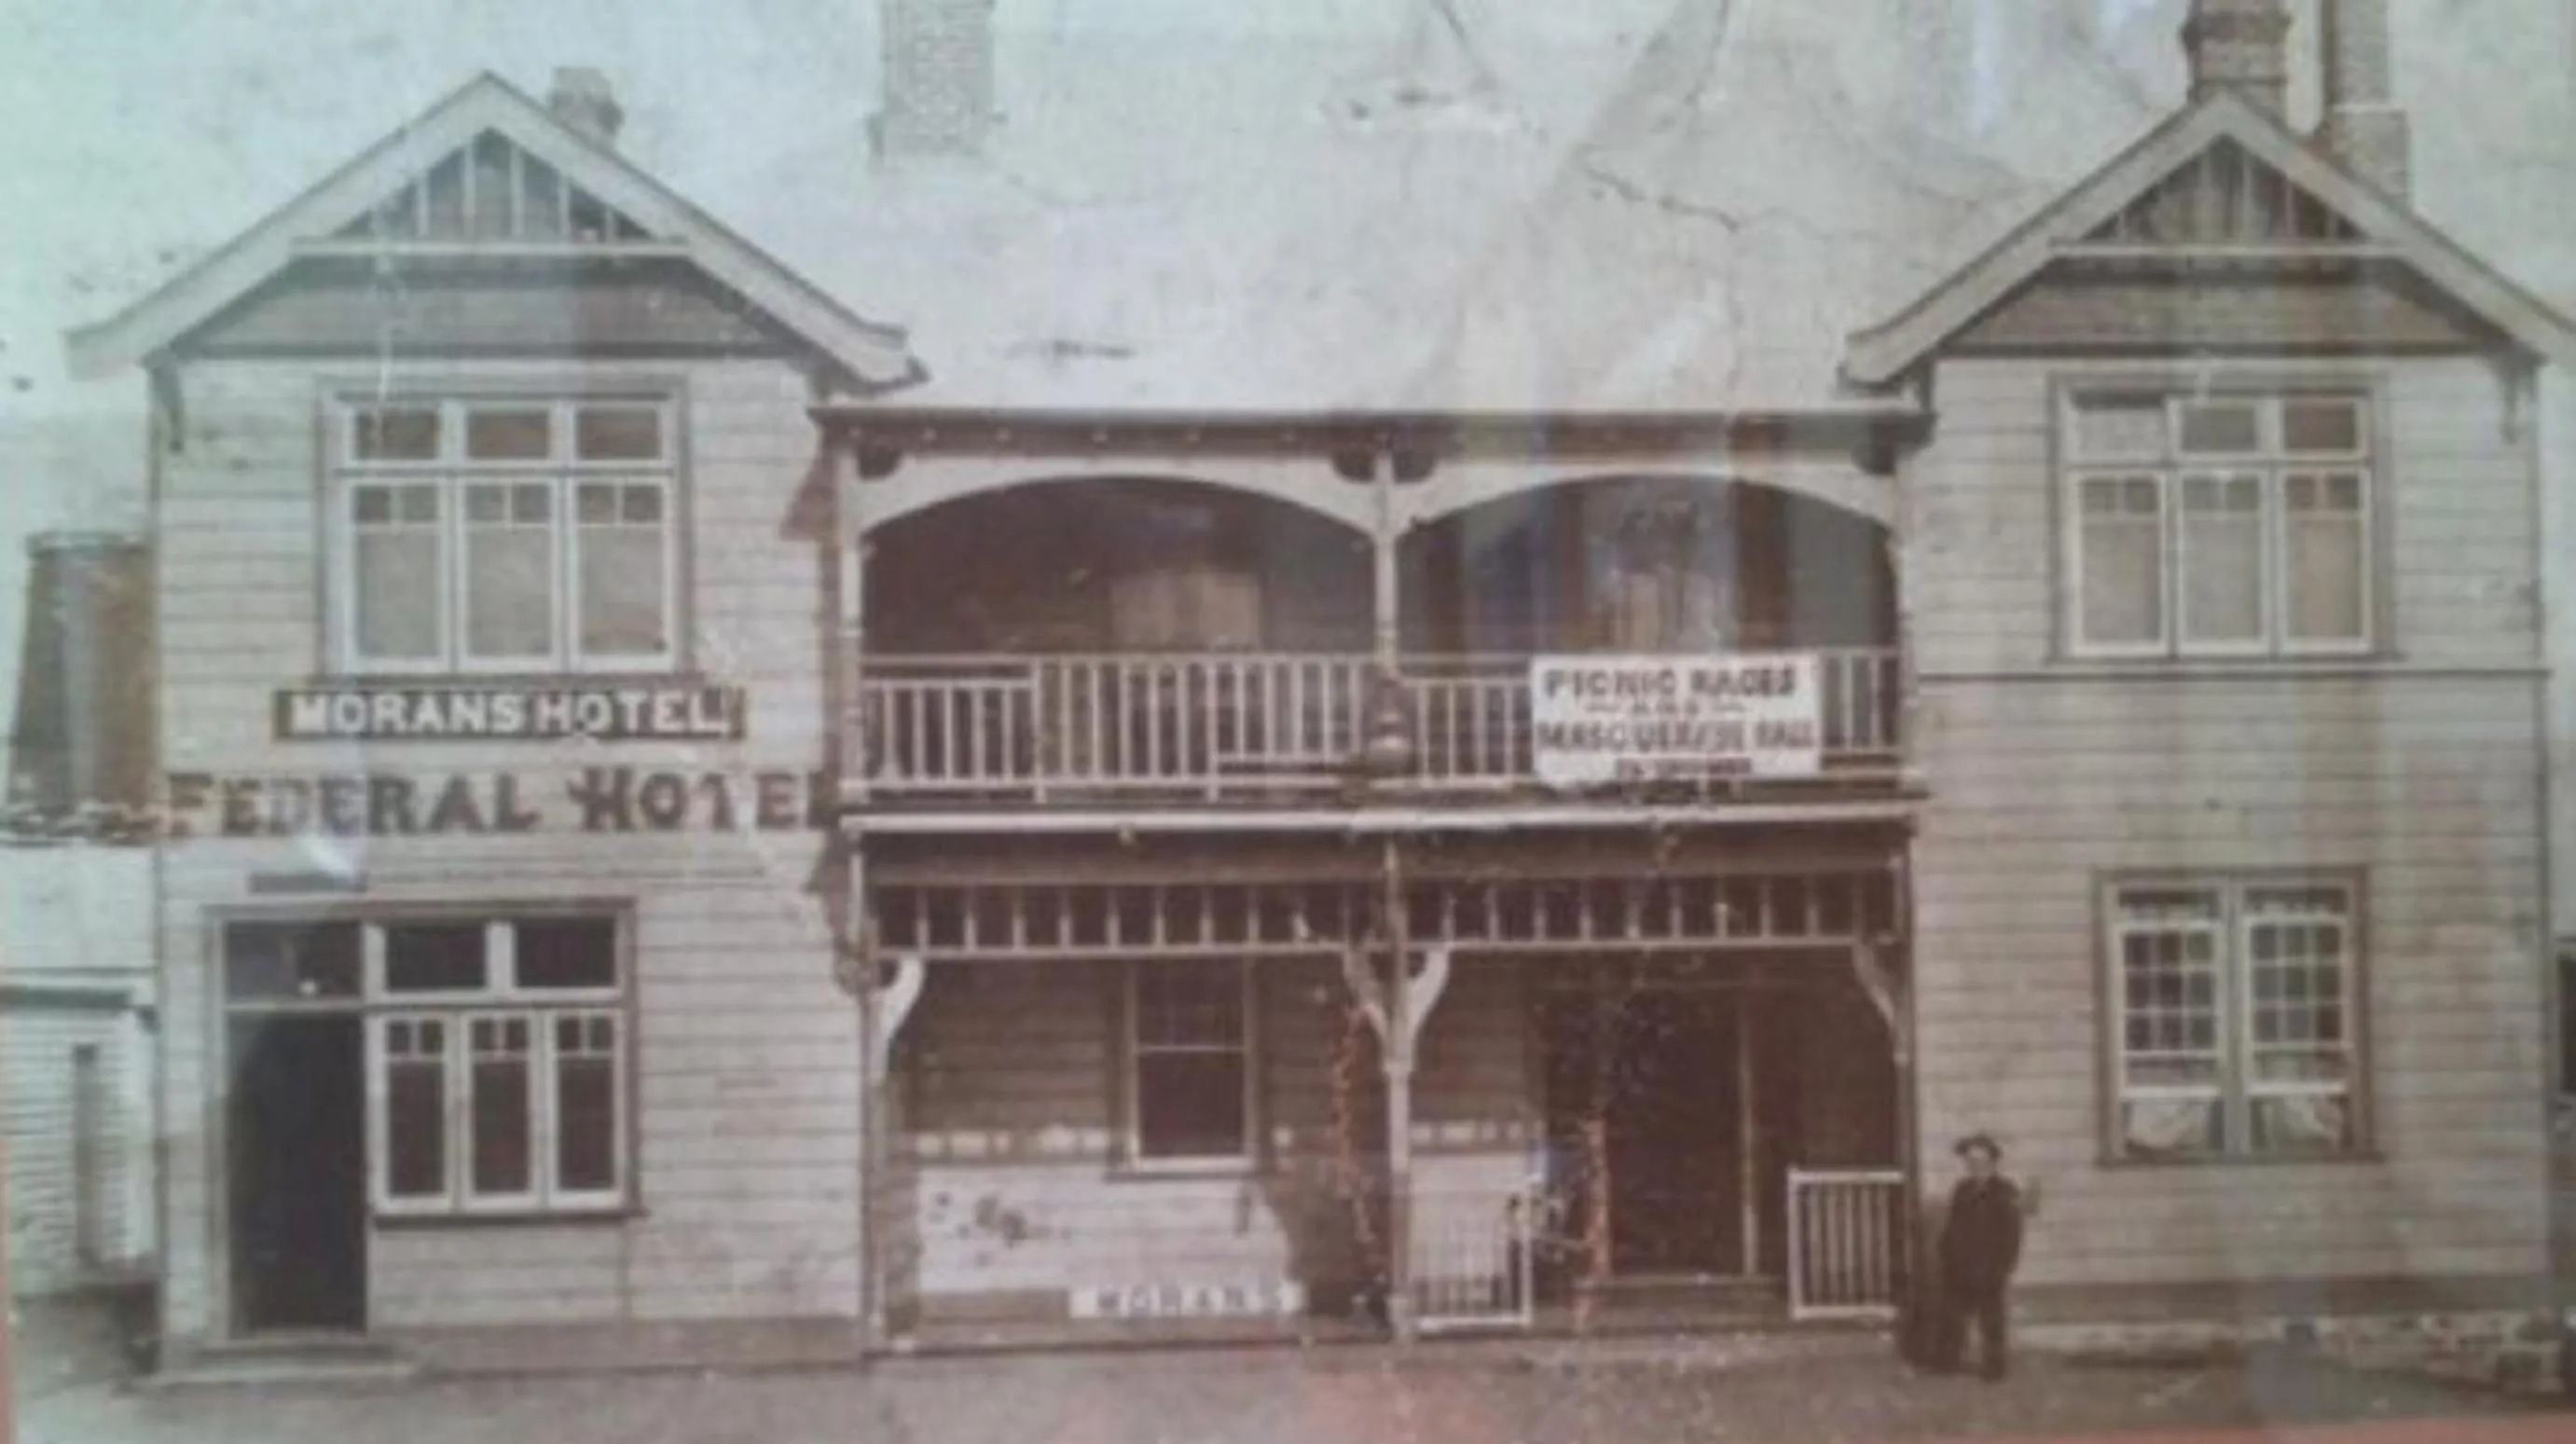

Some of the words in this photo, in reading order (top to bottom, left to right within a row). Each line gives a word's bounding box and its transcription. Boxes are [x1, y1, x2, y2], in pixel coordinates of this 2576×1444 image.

[1545, 667, 1676, 696] PICNIC
[1689, 667, 1796, 696] RACES
[291, 692, 526, 735] MORANS
[534, 690, 731, 735] HOTEL
[168, 770, 543, 837] FEDERAL
